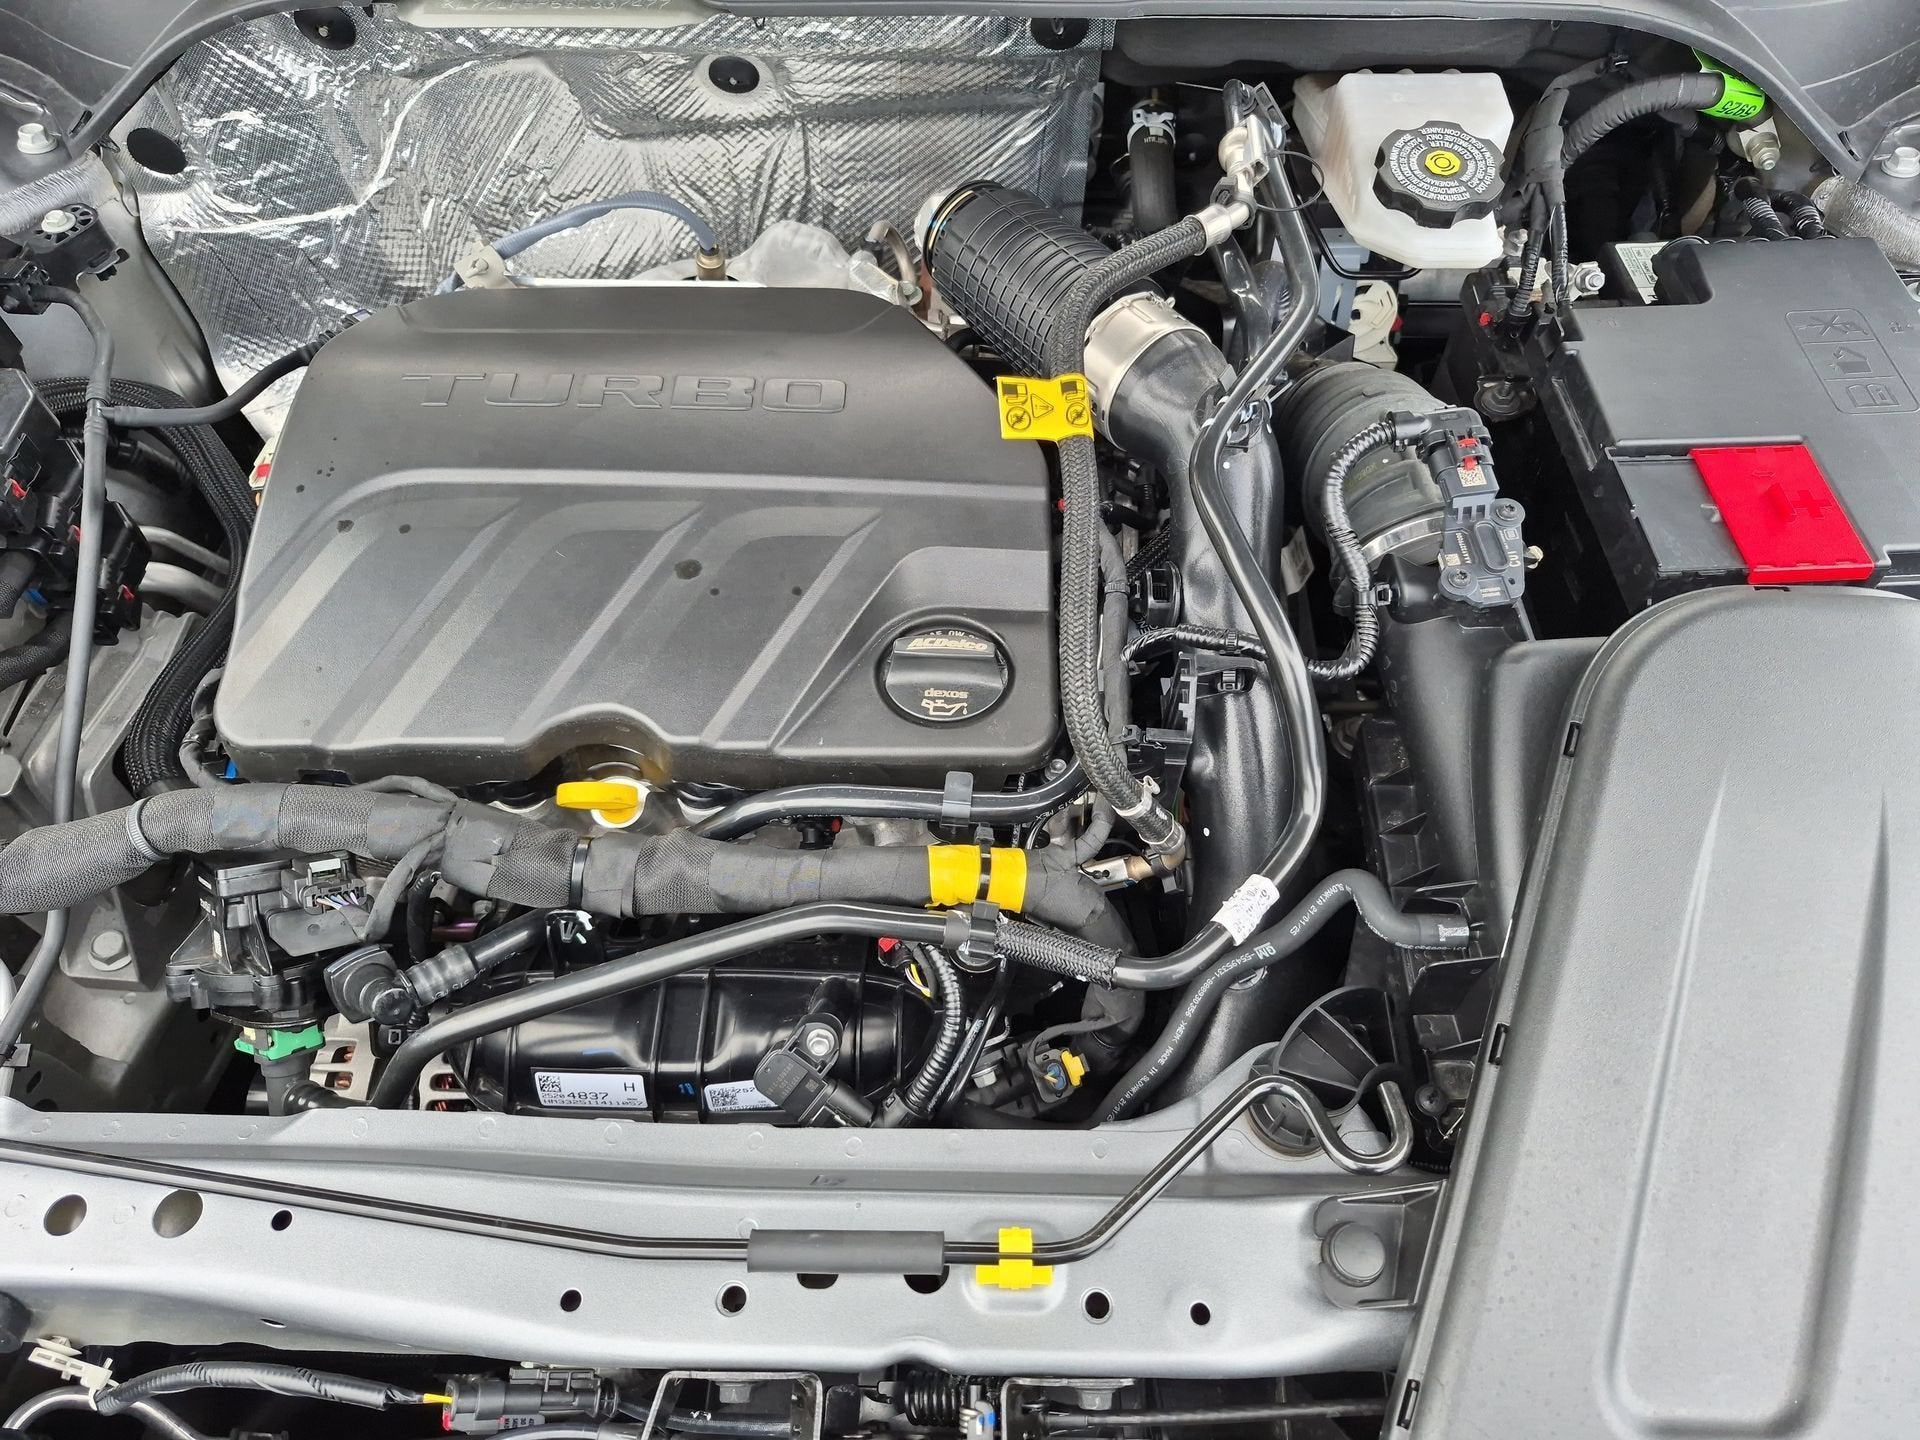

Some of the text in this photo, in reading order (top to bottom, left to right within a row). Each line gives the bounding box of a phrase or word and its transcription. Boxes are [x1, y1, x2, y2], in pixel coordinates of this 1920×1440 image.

[1453, 144, 1473, 159] CLEAN
[402, 373, 847, 413] TURBO
[907, 638, 988, 650] ACDelco
[924, 688, 969, 698] dexos
[1290, 904, 1318, 936] 21/01/25
[1158, 1046, 1174, 1066] MADE
[624, 1082, 636, 1092] H
[1124, 1075, 1150, 1099] SLOVAKIA
